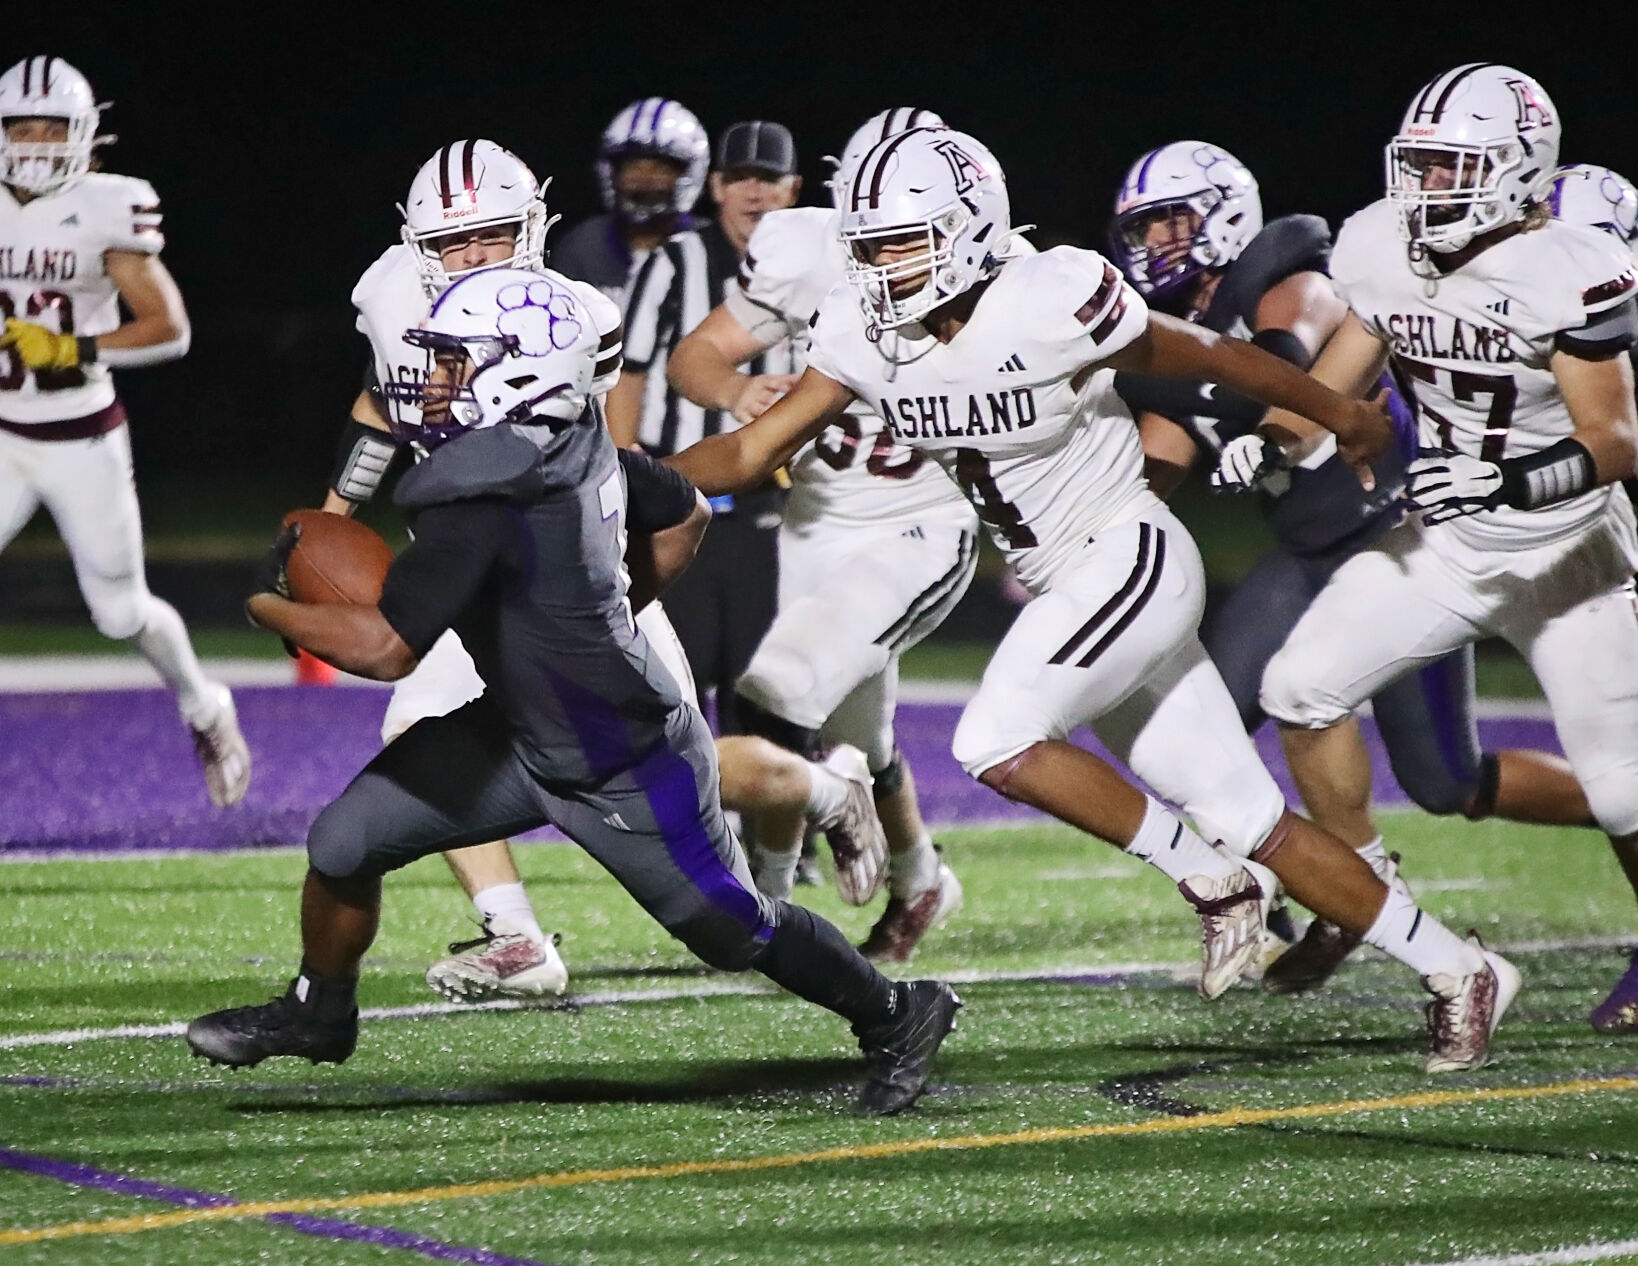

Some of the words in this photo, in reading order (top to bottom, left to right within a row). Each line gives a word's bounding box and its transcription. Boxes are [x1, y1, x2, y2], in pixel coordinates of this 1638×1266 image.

[1505, 79, 1553, 132] A
[933, 140, 992, 196] A
[0, 246, 77, 282] LAND
[879, 387, 1038, 439] ASHLAND
